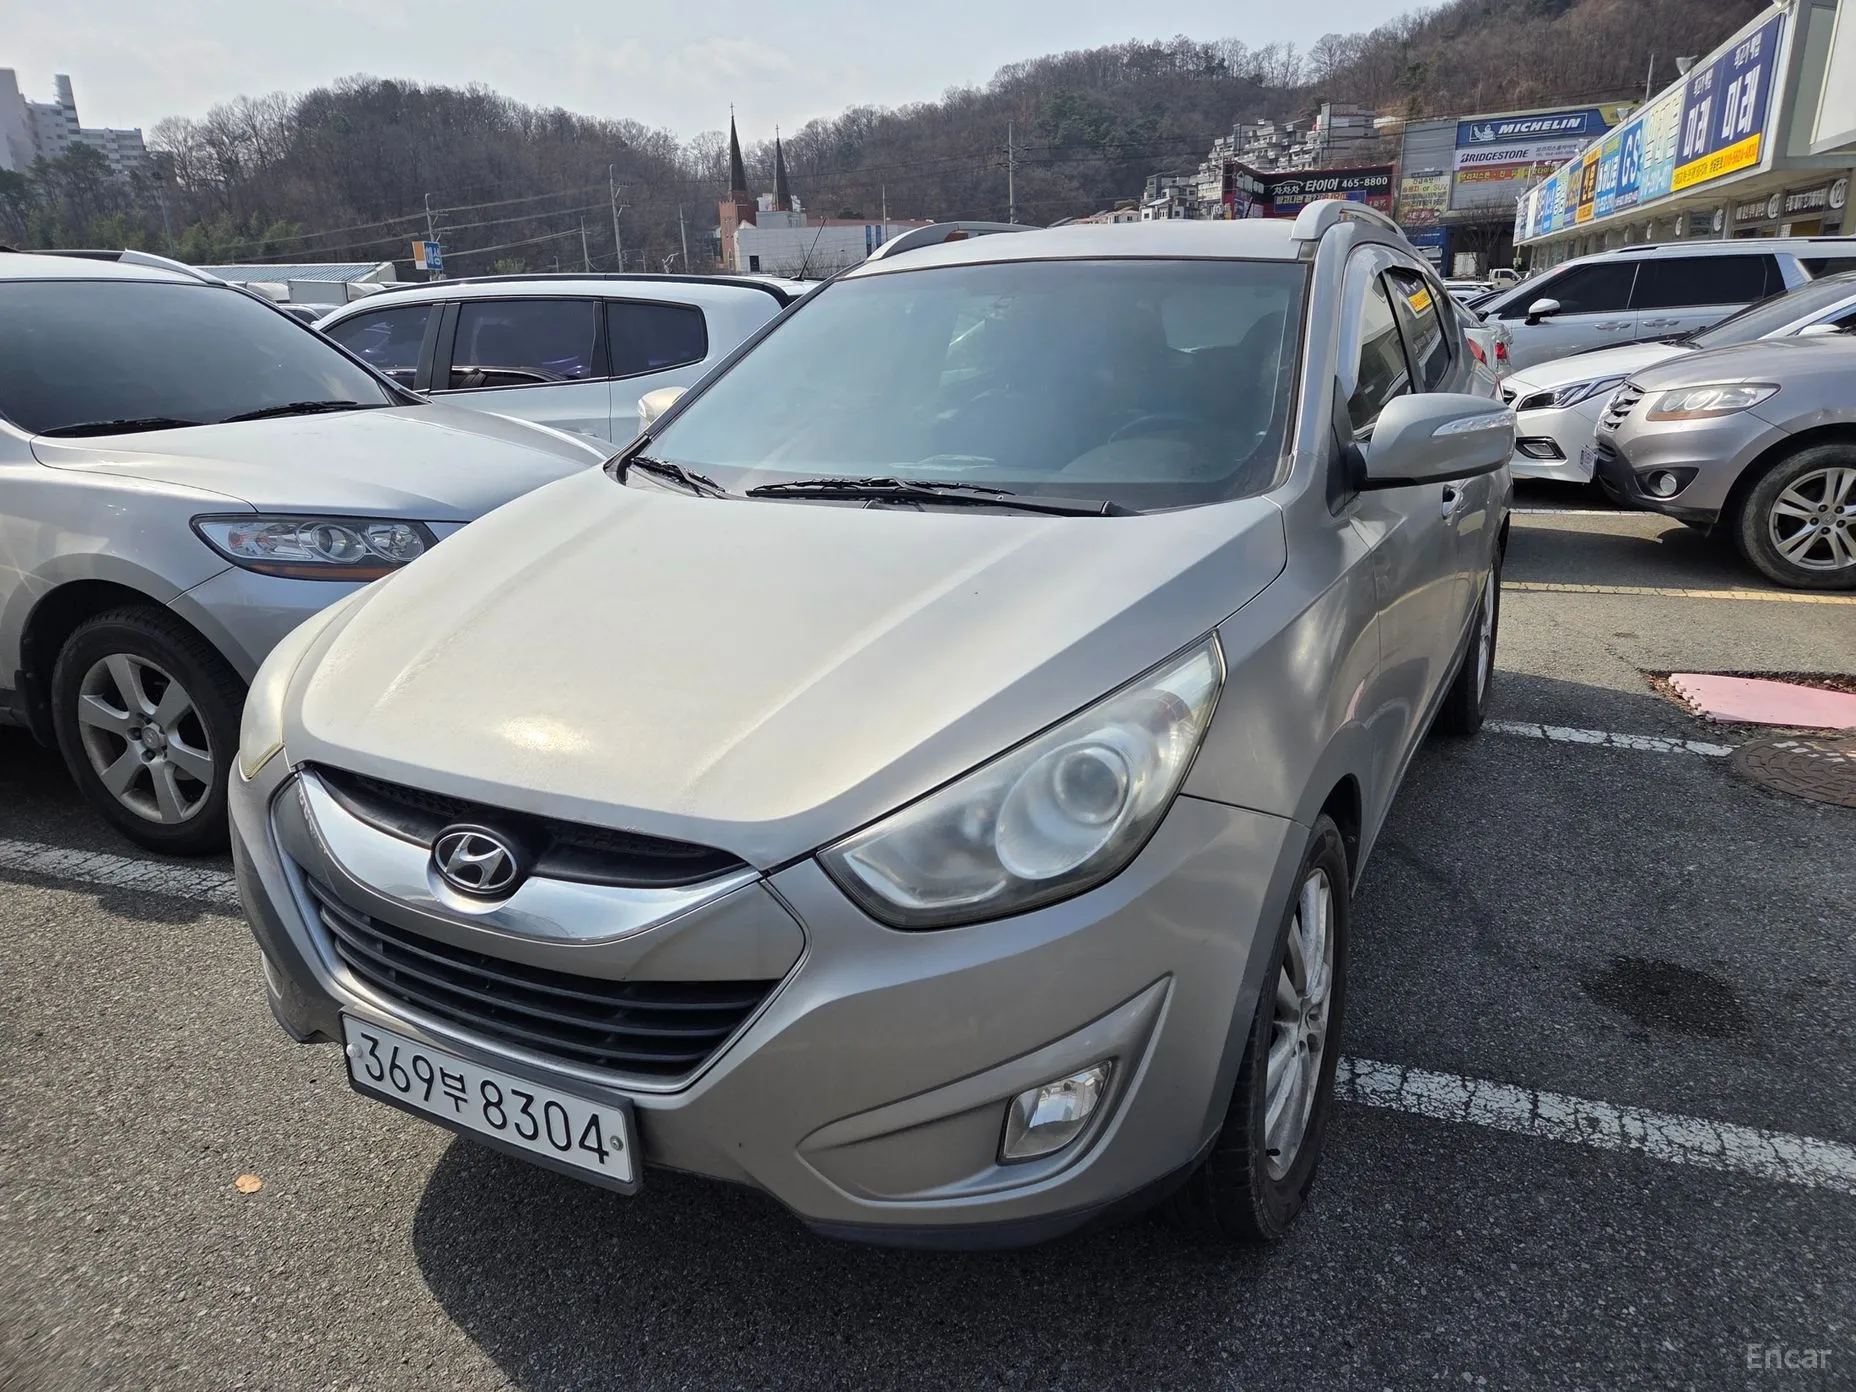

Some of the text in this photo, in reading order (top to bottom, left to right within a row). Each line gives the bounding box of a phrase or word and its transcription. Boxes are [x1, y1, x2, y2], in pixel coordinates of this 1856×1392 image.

[1721, 64, 1761, 140] 미래
[1498, 118, 1581, 134] MICHELIN
[1460, 149, 1529, 163] BRIDGESTONE
[1622, 129, 1641, 187] GS
[1305, 178, 1340, 191] 타이어
[1341, 177, 1388, 188] 465-8800
